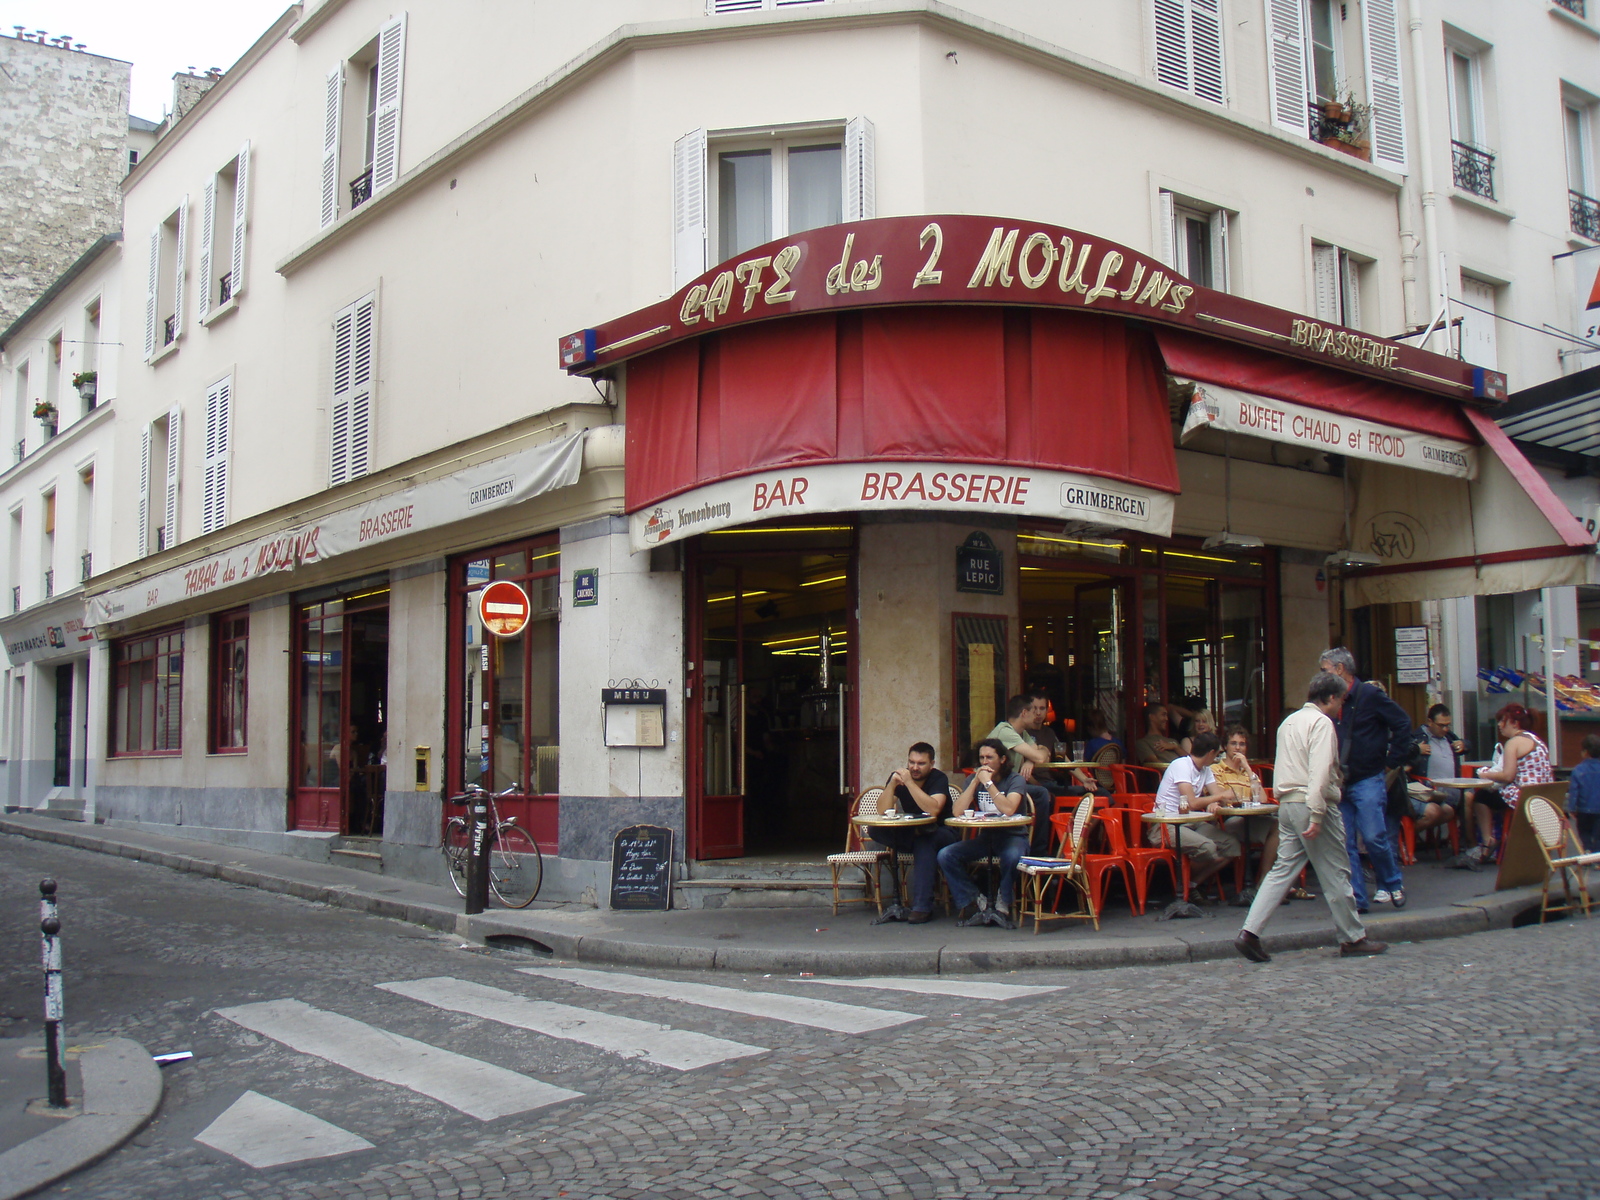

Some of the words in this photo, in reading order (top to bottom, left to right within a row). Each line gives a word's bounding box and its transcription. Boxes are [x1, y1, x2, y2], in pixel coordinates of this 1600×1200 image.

[679, 245, 801, 325] CAFE
[826, 232, 883, 295] des
[913, 223, 943, 289] 2
[967, 227, 1194, 314] MOULINS
[1289, 318, 1400, 372] BRASSERIE
[1239, 402, 1285, 433] BUFFET
[1292, 414, 1342, 445] CHAUD
[1348, 429, 1361, 450] et
[1368, 431, 1405, 459] FROID
[1421, 444, 1468, 468] GRIMBERGEN
[470, 479, 514, 505] GRIMBERGEN
[753, 476, 809, 512] BAR
[861, 472, 1031, 505] BRASSERIE
[1066, 487, 1146, 516] GRIMBERGEN
[358, 504, 414, 543] BRASSERIE
[677, 501, 731, 529] Kronenbourg
[966, 571, 995, 584] LEPIC
[970, 558, 990, 570] RUE
[146, 587, 159, 607] BAR
[184, 560, 220, 597] TABAC
[222, 557, 236, 584] des
[241, 556, 249, 579] 2
[581, 577, 589, 586] RUE
[613, 691, 650, 699] MENU
